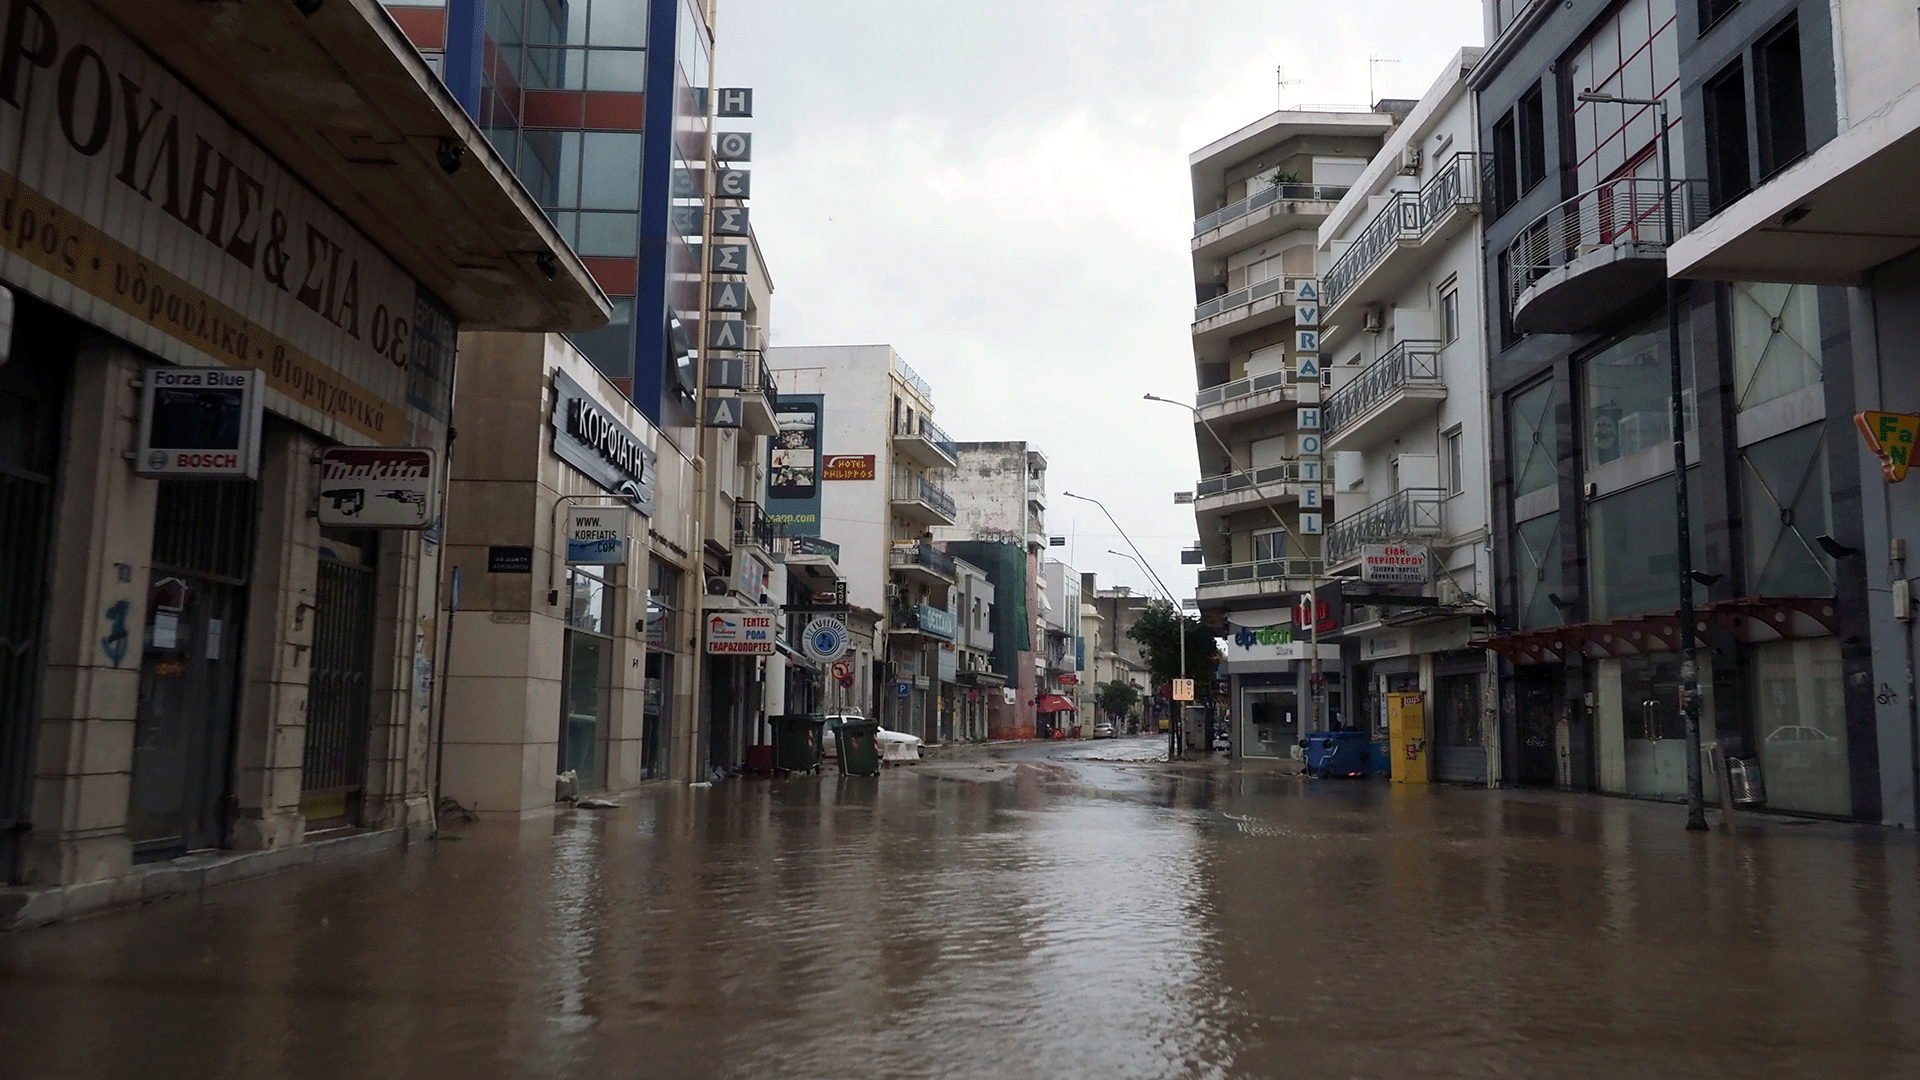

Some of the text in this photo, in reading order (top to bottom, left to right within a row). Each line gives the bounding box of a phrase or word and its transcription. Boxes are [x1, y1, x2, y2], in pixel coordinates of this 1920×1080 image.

[264, 208, 291, 293] &
[297, 221, 360, 340] ΣΙΑ
[155, 371, 245, 386] Forza Blue
[577, 397, 648, 485] ΚΟΡΦΙΑΤΗΣ
[177, 454, 237, 468] BOSCH
[837, 460, 867, 469] HOTEL
[323, 458, 430, 481] makita
[823, 470, 874, 479] PHILIPPOS
[576, 516, 602, 528] WWW.
[574, 529, 618, 541] KORFIATIS
[594, 541, 616, 553] .COM
[742, 617, 770, 627] ΤΕΝΤΕΣ
[746, 630, 767, 640] ΡΟΛΑ
[709, 641, 772, 652] ΓΚΑΡΑΖΟΠΟΡΤΕΣ
